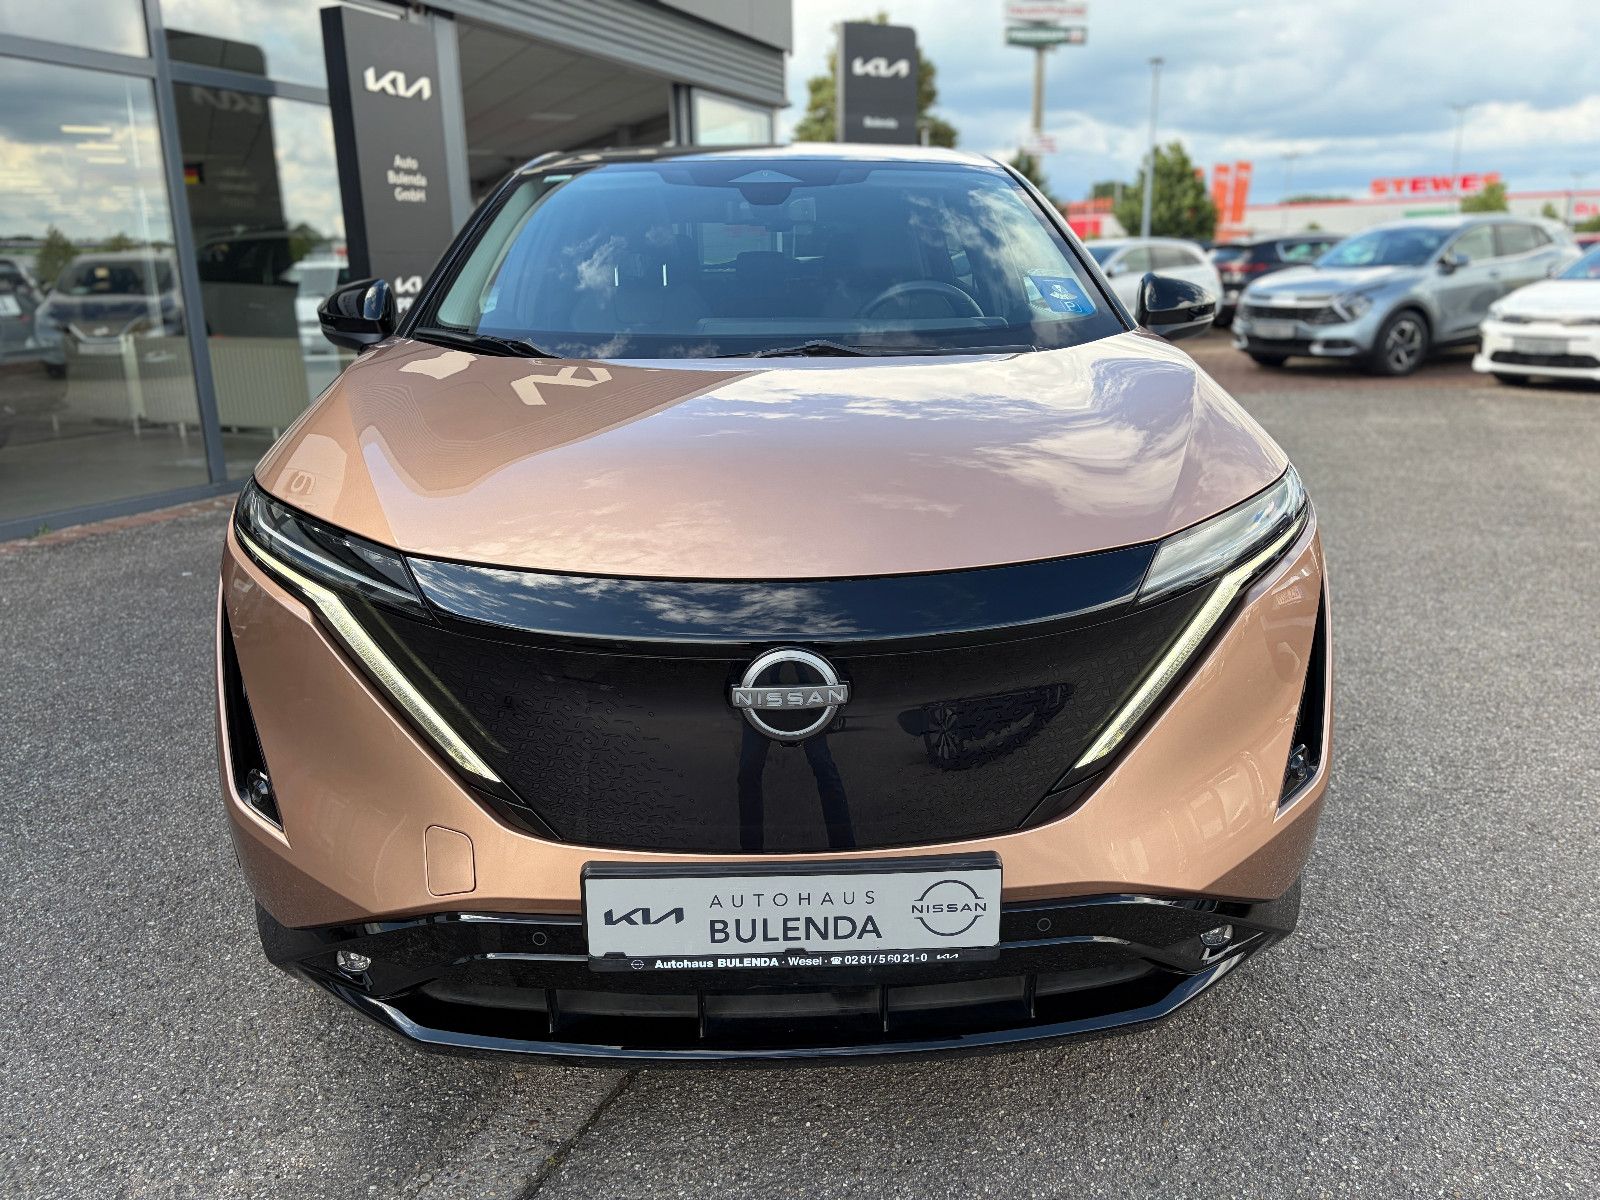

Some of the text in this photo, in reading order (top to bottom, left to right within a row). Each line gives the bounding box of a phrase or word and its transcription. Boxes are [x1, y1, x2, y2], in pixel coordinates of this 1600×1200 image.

[853, 56, 909, 78] KIA
[364, 66, 432, 100] KIA
[394, 154, 419, 169] Auto
[387, 169, 427, 187] Bulenda
[394, 186, 426, 202] GmbH
[395, 275, 422, 294] KI
[735, 688, 845, 706] NISSAN
[709, 890, 875, 909] AUTOHAUS
[911, 902, 987, 914] NISSAN
[604, 907, 684, 926] KIA
[709, 915, 883, 944] BULENDA
[655, 959, 713, 969] Autohaus
[717, 957, 779, 968] BULENDA
[788, 956, 822, 966] Wesel
